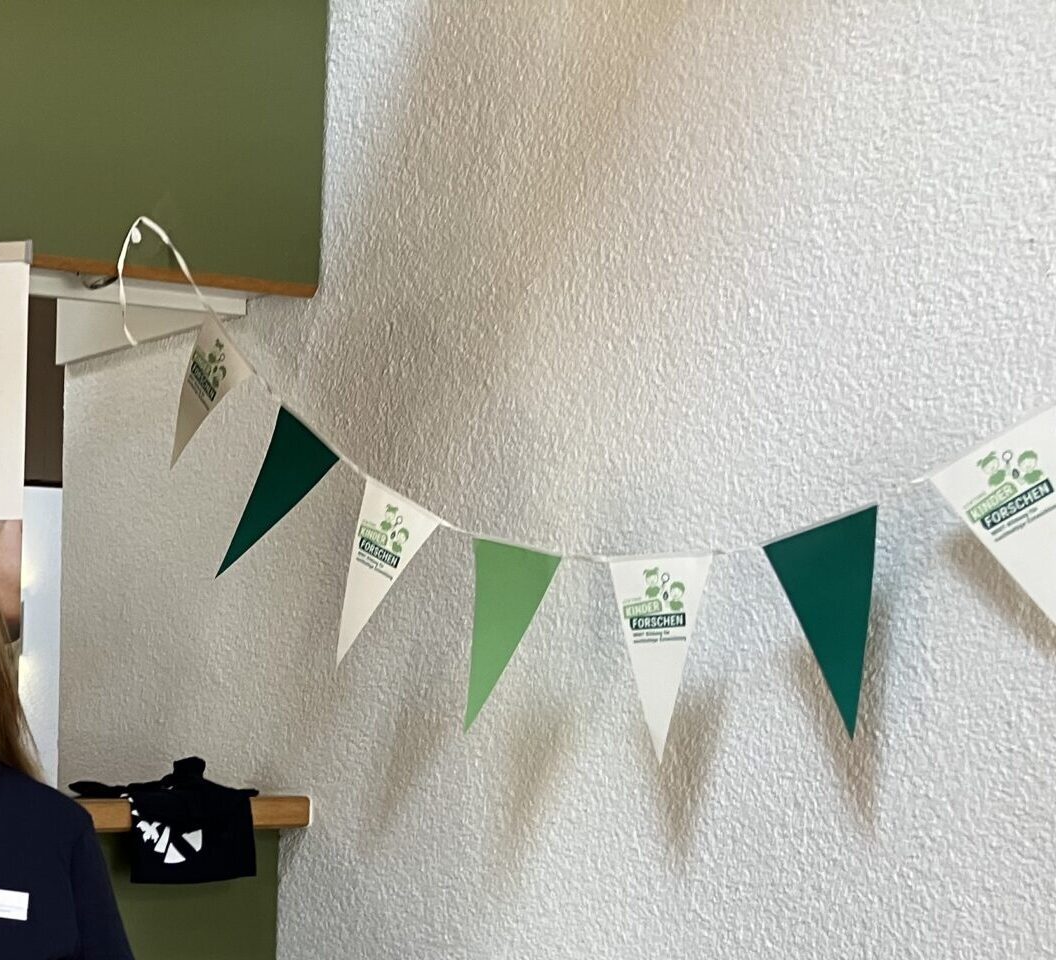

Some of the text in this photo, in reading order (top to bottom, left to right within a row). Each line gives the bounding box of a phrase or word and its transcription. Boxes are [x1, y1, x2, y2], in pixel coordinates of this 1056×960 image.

[984, 482, 1050, 528] FORSCHEN
[360, 540, 399, 567] FORSCHEN
[632, 614, 684, 629] FORSCHEN
